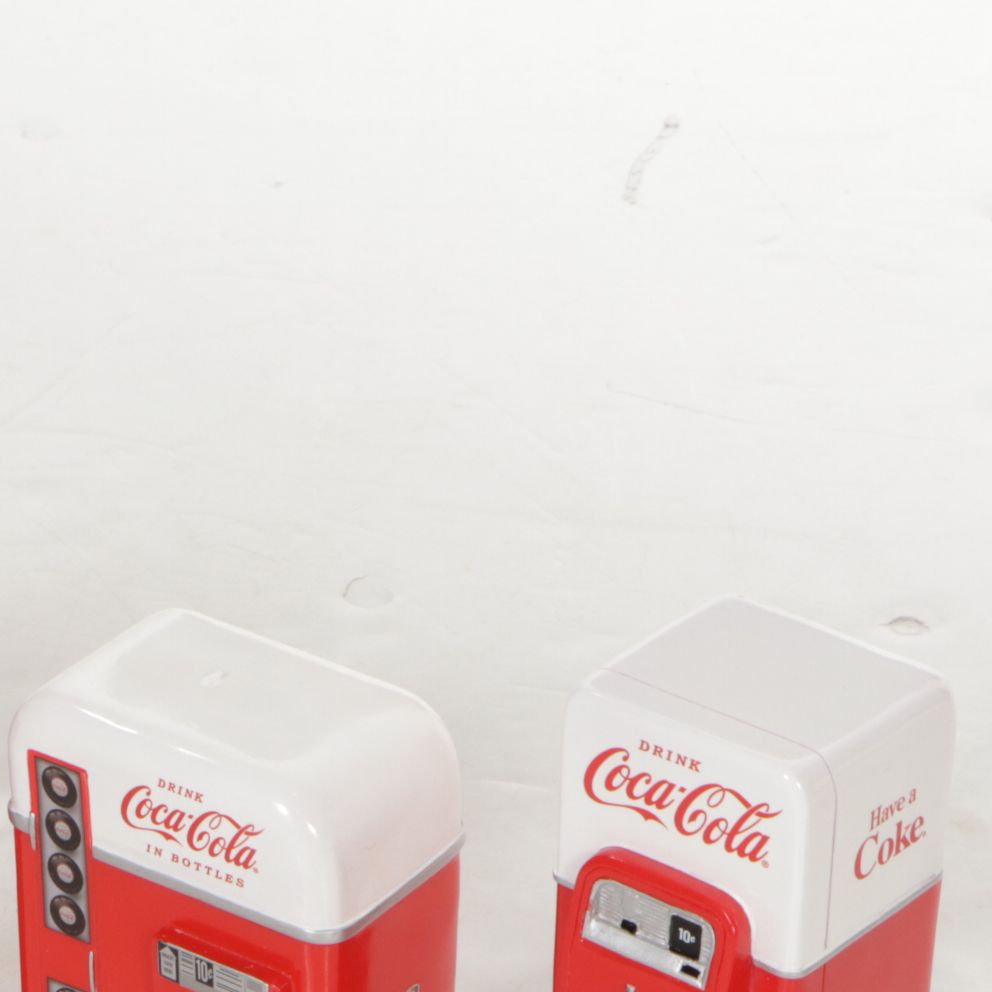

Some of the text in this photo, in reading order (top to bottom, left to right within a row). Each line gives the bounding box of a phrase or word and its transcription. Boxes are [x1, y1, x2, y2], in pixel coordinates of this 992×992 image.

[637, 738, 702, 774] DRINK
[157, 777, 205, 804] DRINK
[583, 746, 784, 864] Coca-Cola
[869, 787, 917, 832] Have a
[120, 784, 265, 871] Coca-Cola
[853, 815, 925, 880] Coke
[146, 844, 247, 889] IN BOTTLES
